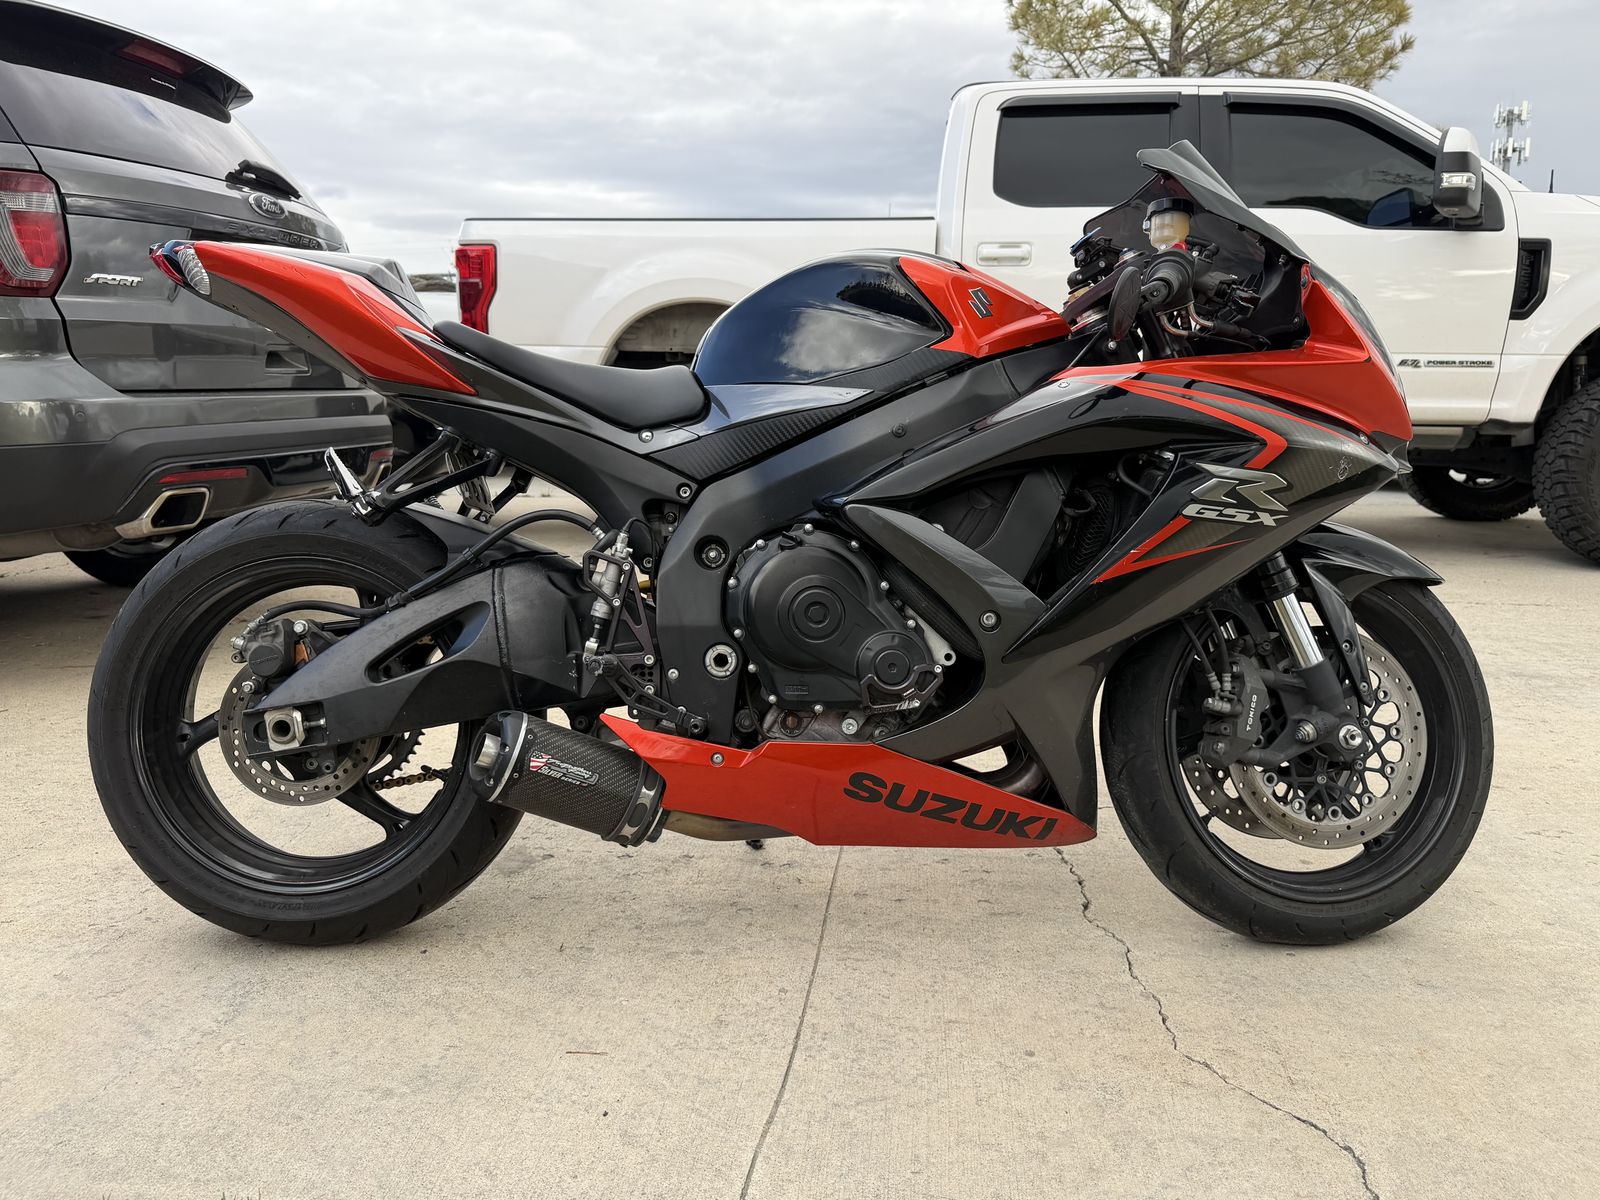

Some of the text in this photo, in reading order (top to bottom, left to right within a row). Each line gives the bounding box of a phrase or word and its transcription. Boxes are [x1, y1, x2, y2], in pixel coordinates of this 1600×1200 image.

[261, 196, 282, 214] Ford
[83, 273, 144, 287] SPORT
[1181, 503, 1290, 527] GSX
[539, 765, 563, 779] SILVER
[843, 771, 1059, 841] SUZUKI
